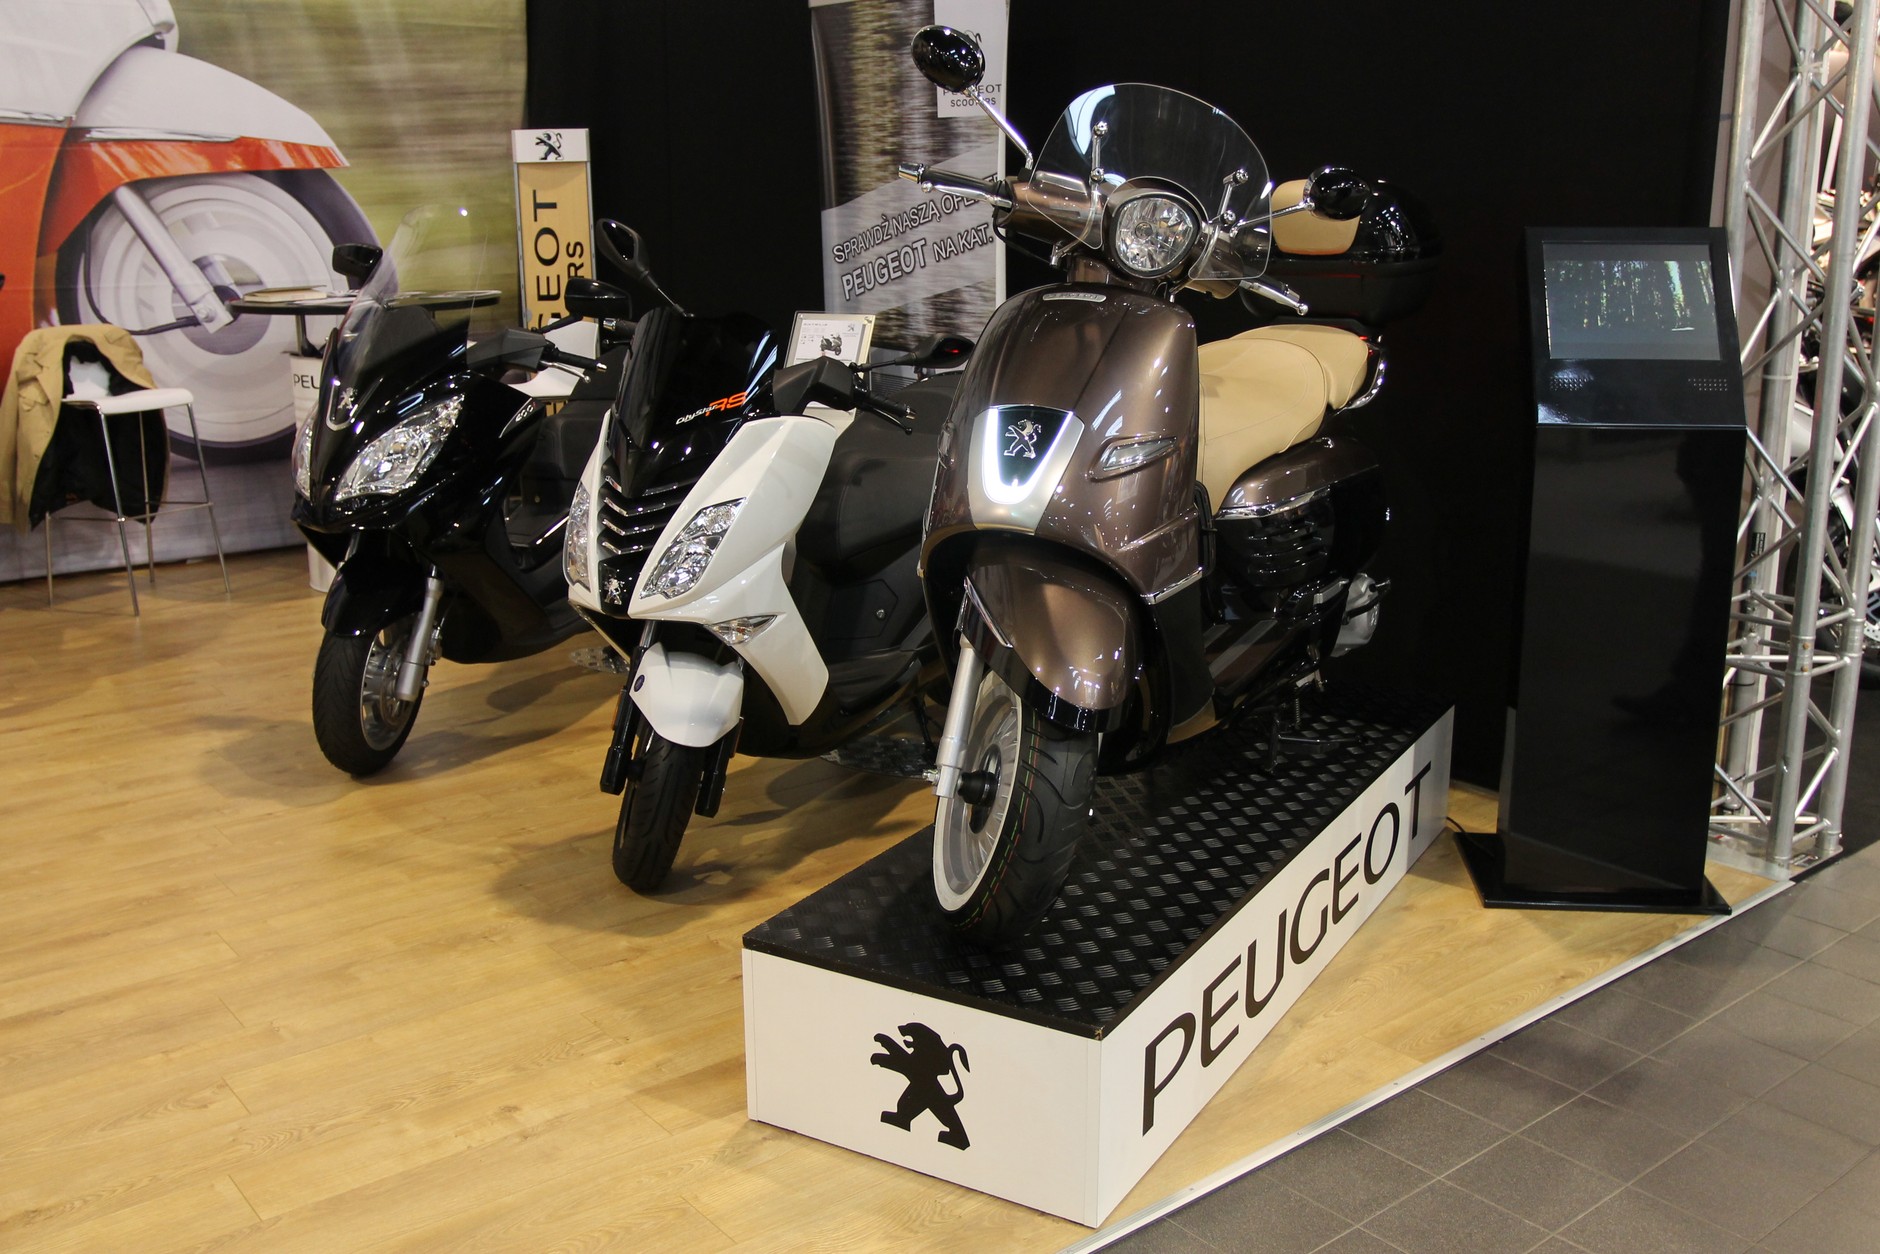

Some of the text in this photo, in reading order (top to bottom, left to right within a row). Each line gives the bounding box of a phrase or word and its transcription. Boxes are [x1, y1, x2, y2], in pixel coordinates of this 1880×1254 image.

[892, 199, 941, 235] NASZĄ
[841, 223, 994, 301] PEUGEOT NA KAT.
[1142, 761, 1431, 1137] PEUGEOT
